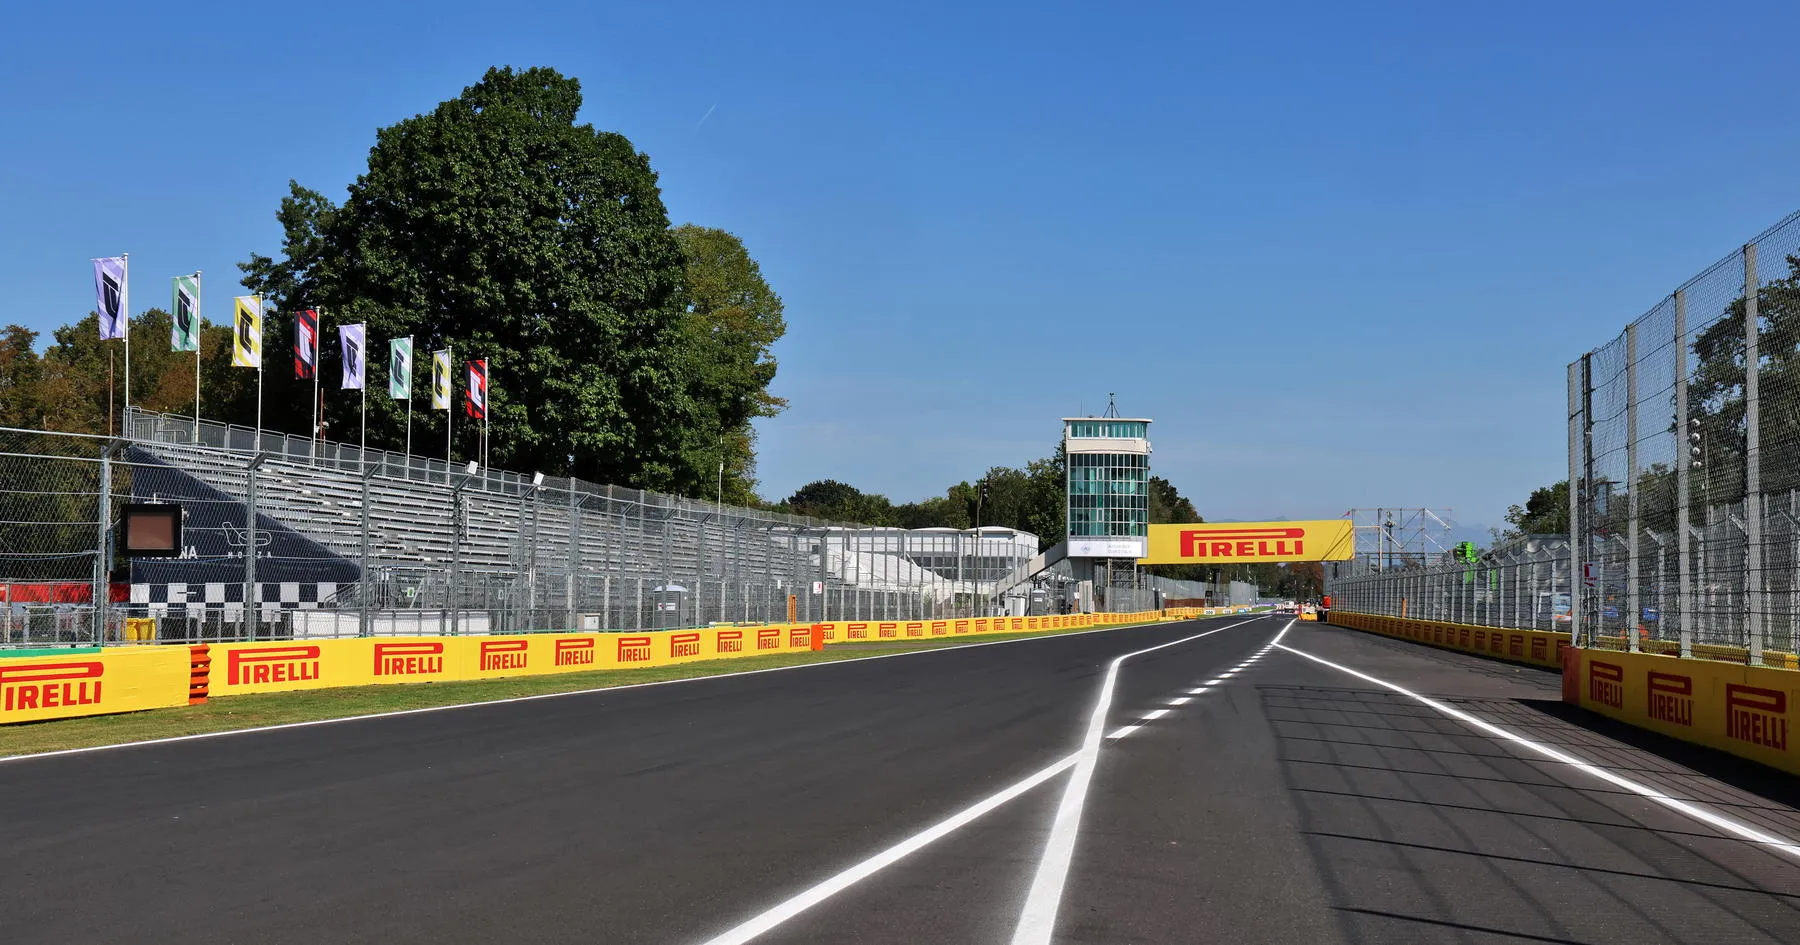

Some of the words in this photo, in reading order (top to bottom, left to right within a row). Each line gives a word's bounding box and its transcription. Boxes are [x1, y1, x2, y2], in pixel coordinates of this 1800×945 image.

[227, 551, 272, 559] MOZA
[1179, 527, 1306, 559] PIRELLI
[670, 633, 701, 659] PIRELLI
[717, 631, 744, 653] PIRELLI
[757, 629, 781, 650] PIRELLI
[790, 627, 811, 647] PIRELLI
[848, 624, 868, 639] PIRELLI
[374, 642, 445, 677] PIRELLI
[480, 640, 529, 672] PIRELLI
[555, 638, 596, 667] PIRELLI
[617, 637, 652, 663] PIRELLI
[228, 645, 321, 686] PIRELLI
[0, 660, 105, 712] PIRELLI
[1590, 659, 1623, 710] PIRELLI
[1647, 671, 1693, 727] PIRELLI
[1725, 683, 1787, 751] PIRELLI
